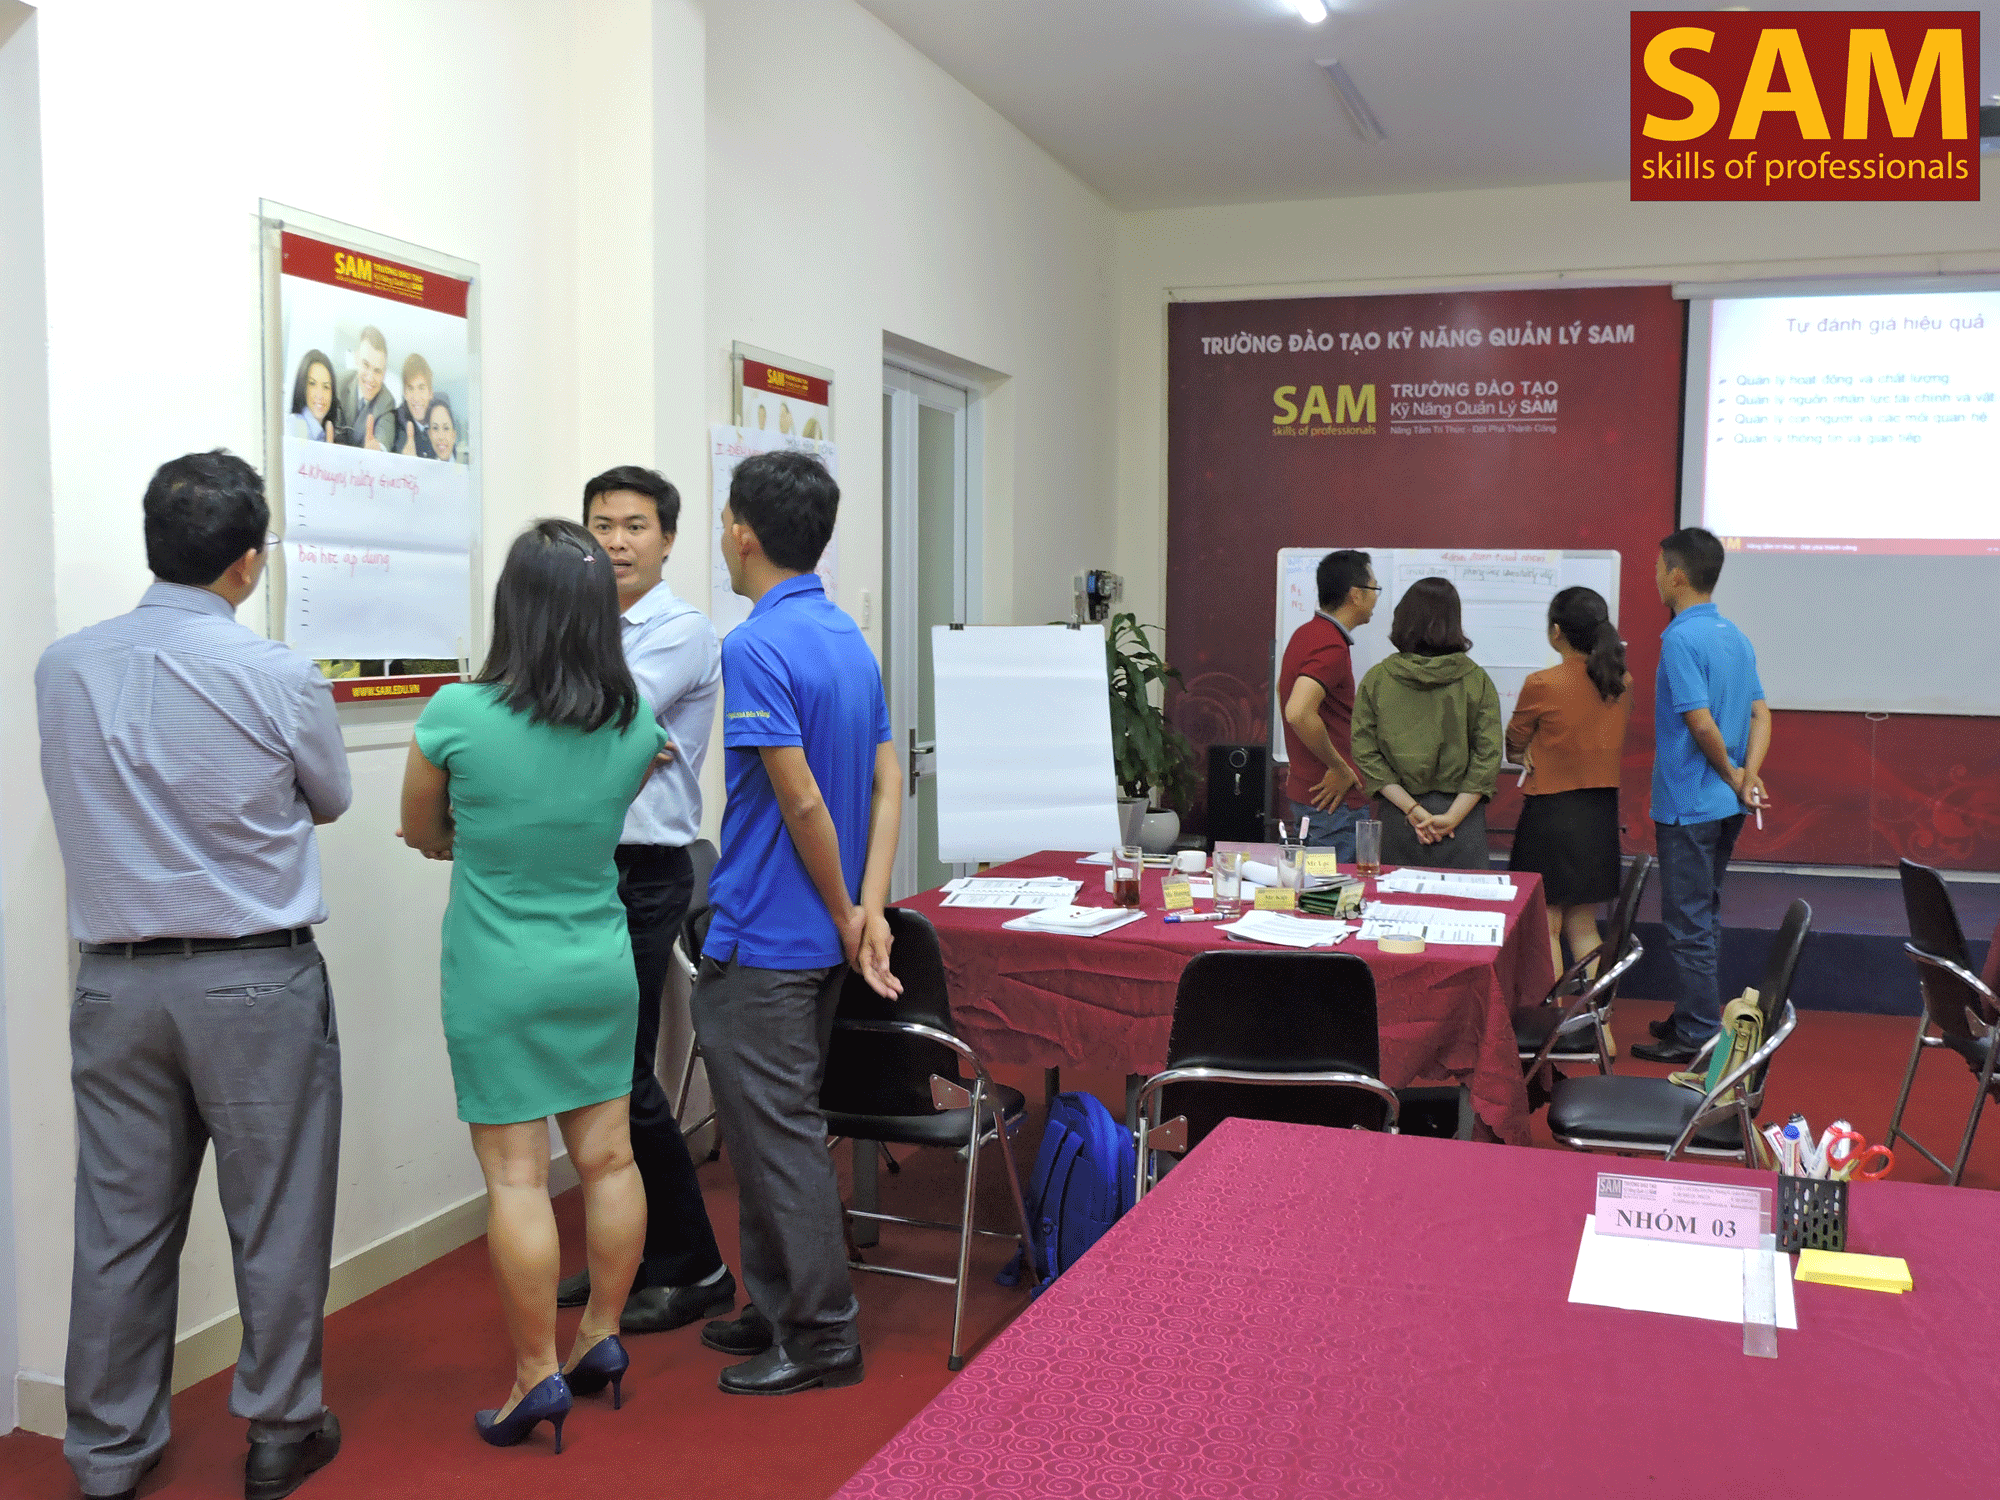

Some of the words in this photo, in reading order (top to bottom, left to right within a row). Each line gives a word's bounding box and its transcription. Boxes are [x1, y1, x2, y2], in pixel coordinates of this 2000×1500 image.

[334, 252, 372, 282] SAM
[1817, 318, 1862, 332] đánh
[1869, 317, 1897, 335] giá
[1904, 315, 1942, 332] hiệu
[1950, 313, 1985, 332] quả
[1201, 331, 1283, 355] TRƯỜNG
[1288, 328, 1335, 352] ĐÀO
[1339, 332, 1381, 356] TẠO
[1387, 326, 1414, 350] KỸ
[1419, 325, 1483, 349] NĂNG
[1488, 320, 1551, 347] QUẢN
[1559, 320, 1583, 345] LÝ
[1588, 324, 1635, 344] SAM
[1391, 380, 1470, 398] TRƯỜNG
[1475, 378, 1515, 396] ĐÀO
[1520, 380, 1559, 399] TẠO
[1272, 384, 1377, 425] SAM
[1390, 401, 1410, 419] Kỹ
[1413, 401, 1452, 419] Năng
[1455, 400, 1495, 416] Quản
[1520, 399, 1558, 414] SAM
[1273, 425, 1296, 436] skills
[1298, 425, 1309, 436] of
[1310, 425, 1377, 437] professionals
[1599, 1178, 1622, 1194] SAM
[1616, 1208, 1698, 1235] NHÓM
[1712, 1218, 1737, 1239] 03
